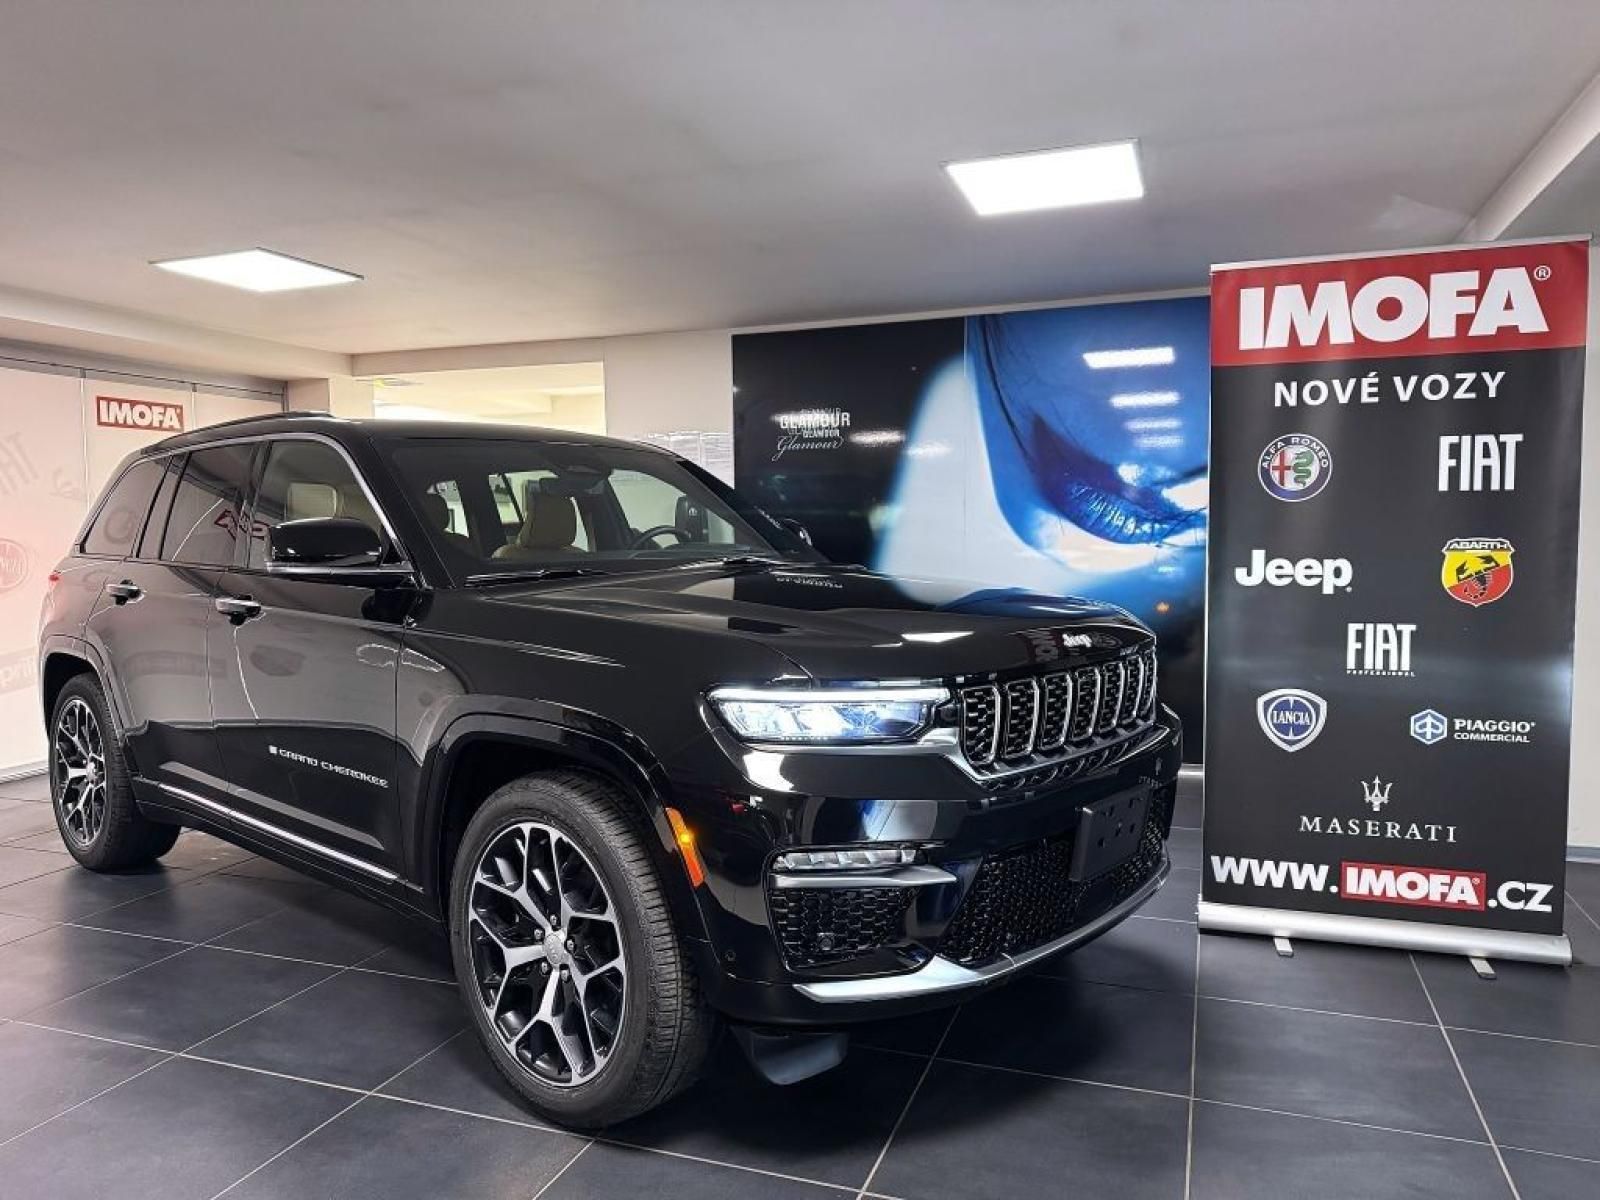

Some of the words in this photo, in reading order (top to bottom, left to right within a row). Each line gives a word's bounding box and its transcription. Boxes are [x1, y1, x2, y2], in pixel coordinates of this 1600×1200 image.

[1274, 371, 1380, 407] NOVÉ
[1394, 371, 1506, 401] VOZY
[99, 399, 182, 430] IMOFA
[779, 411, 851, 430] GLAMOUR
[771, 435, 845, 462] Glamour
[1262, 441, 1285, 469] ALFA
[1291, 437, 1329, 469] ROMEO
[1438, 433, 1523, 492] FIAT
[1449, 541, 1508, 550] ABARTH
[1234, 549, 1353, 595] Jeep
[1346, 622, 1417, 671] FIAT
[1272, 710, 1311, 726] LANCIA
[1453, 718, 1531, 734] PIAGGIO
[1453, 732, 1531, 743] COMMERCIAL
[1299, 815, 1457, 843] MASERATI
